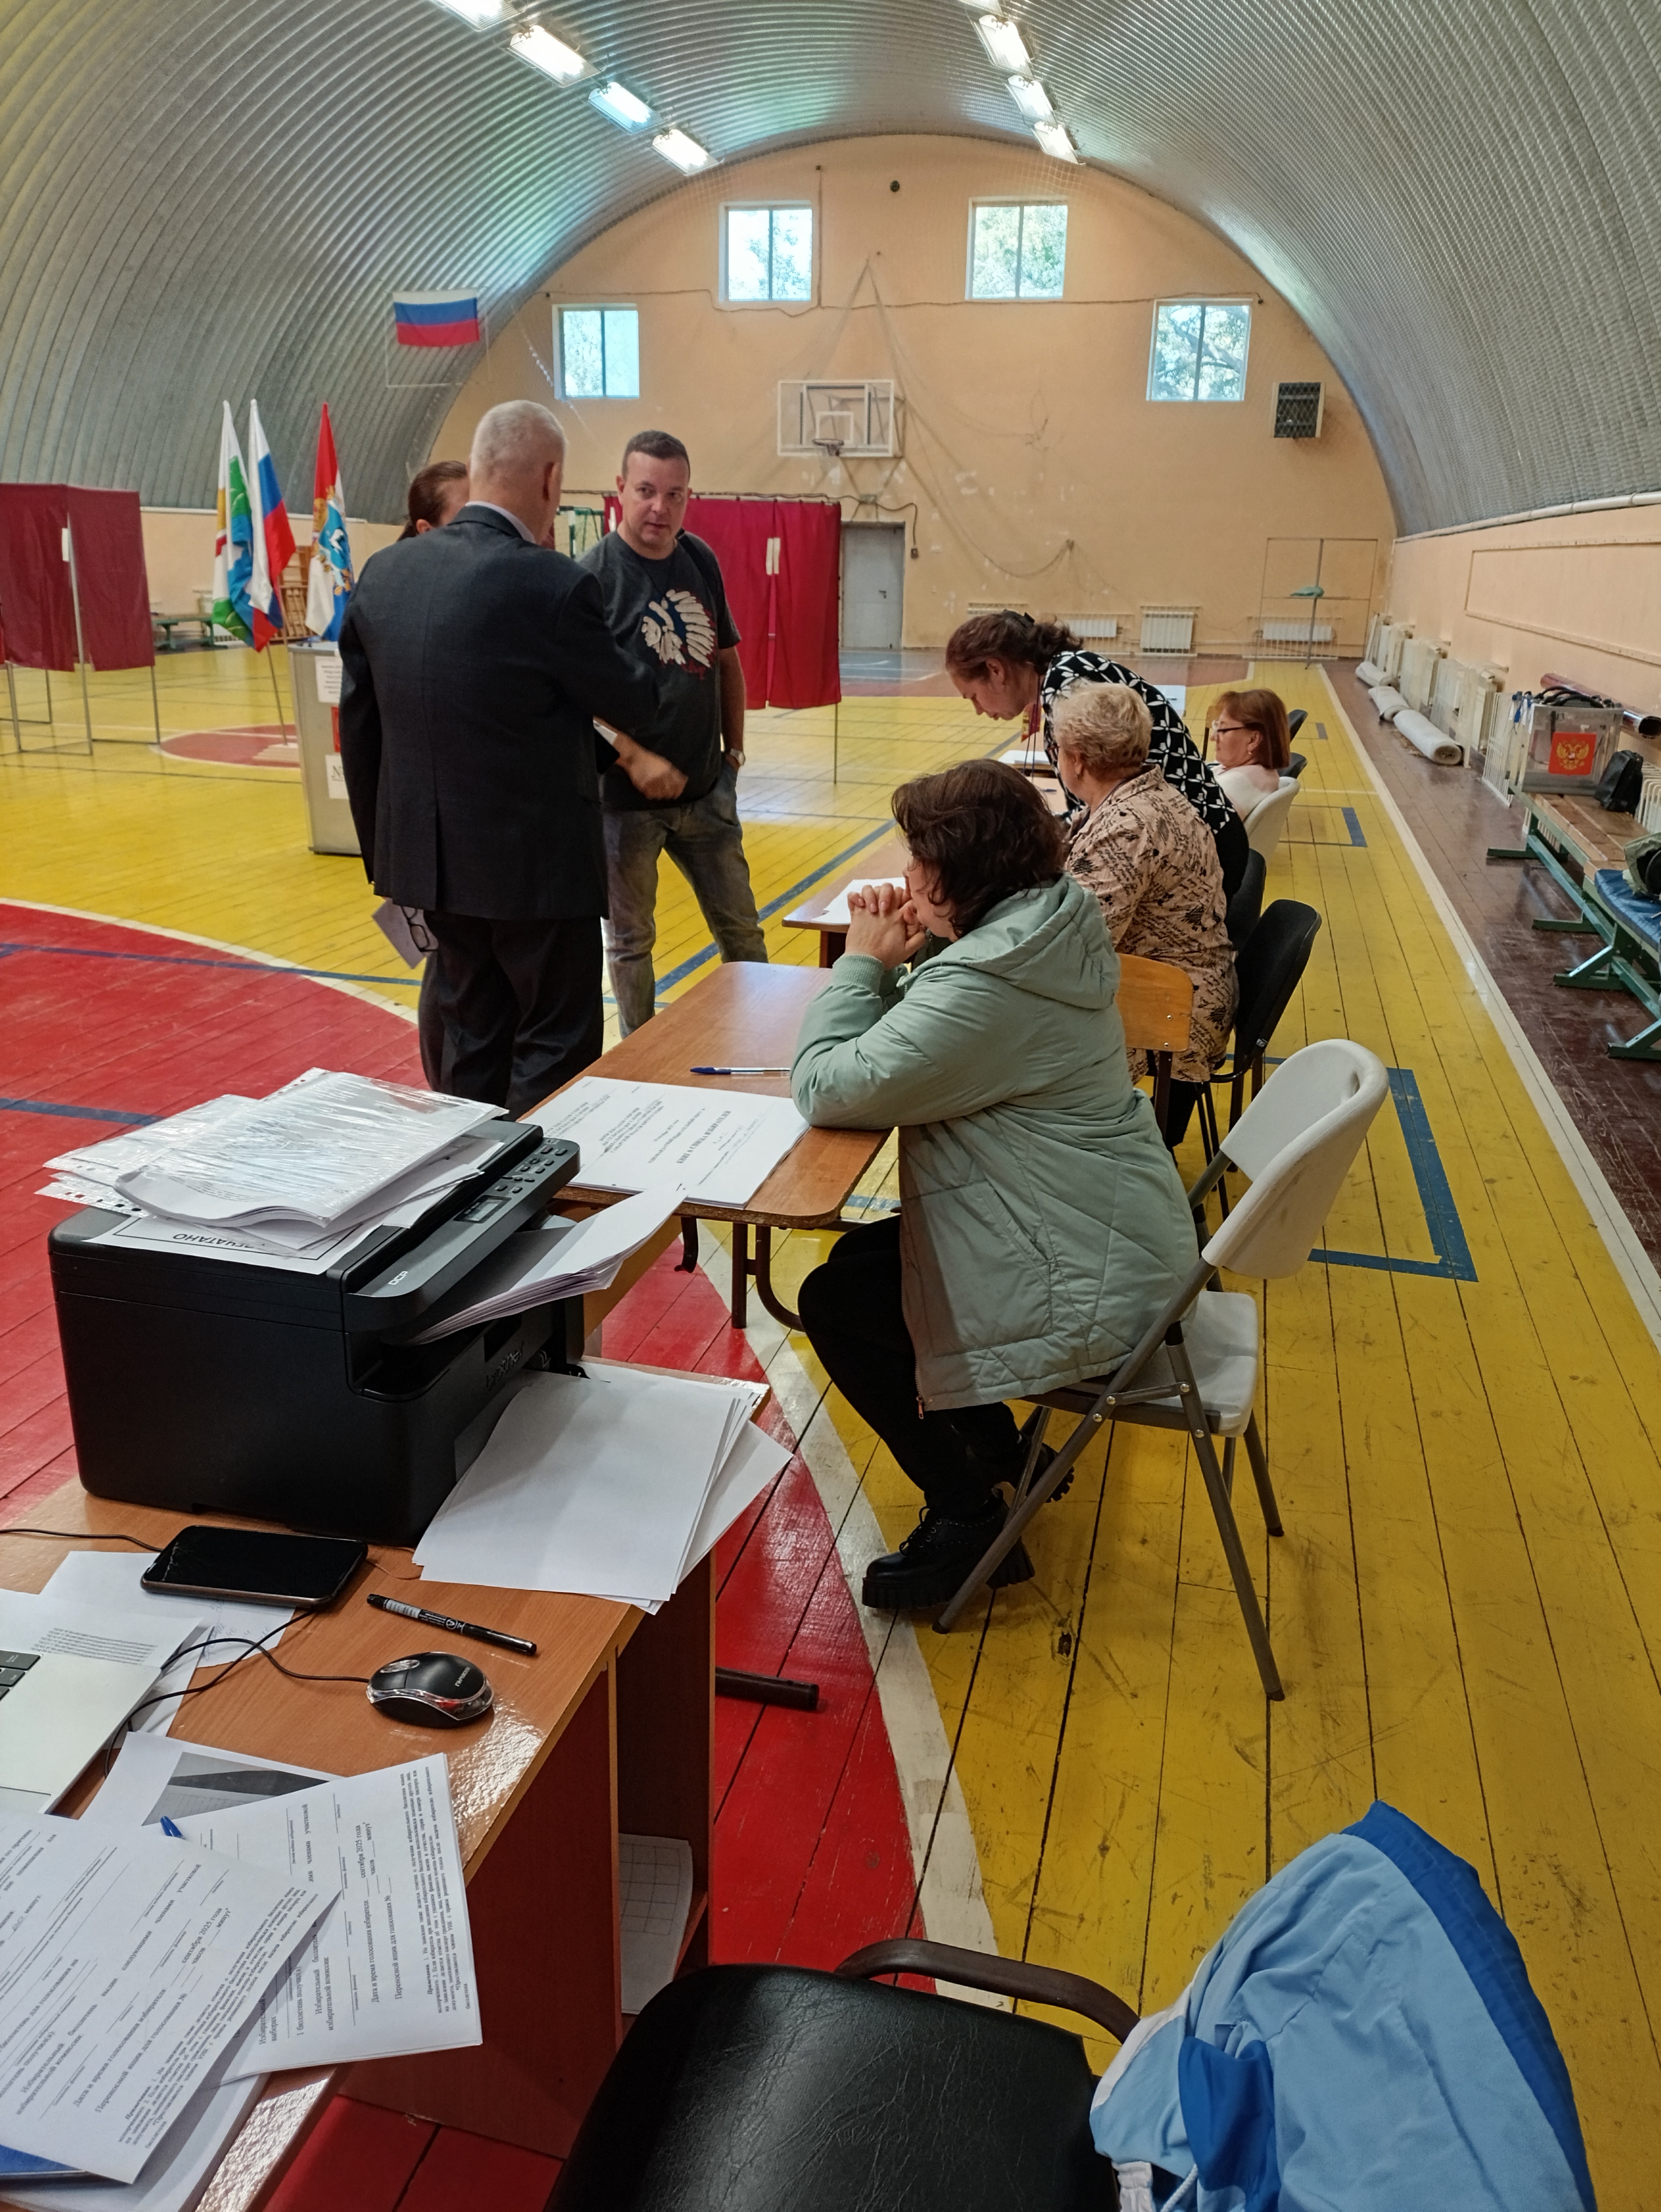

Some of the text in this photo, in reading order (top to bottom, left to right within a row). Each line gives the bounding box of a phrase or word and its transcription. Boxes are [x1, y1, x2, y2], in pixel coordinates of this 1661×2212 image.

[675, 1149, 694, 1164] КНИГА
[688, 1133, 709, 1150] СПИСКА
[703, 1110, 731, 1137] ИЗБИРАТЕЛЕЙ
[388, 1271, 408, 1285] DCP
[301, 1803, 311, 1835] участковой
[354, 1838, 364, 1853] 2025
[357, 1853, 366, 1879] сентября
[386, 1902, 395, 1934] голосования
[181, 1935, 203, 1964] сентября
[198, 1920, 212, 1936] 2025
[210, 1907, 223, 1921] года
[365, 1929, 375, 1963] голосования
[190, 1947, 206, 1964] часов
[369, 1963, 378, 1982] время
[391, 1961, 402, 2000] Переносной
[323, 1985, 334, 2031] избирательной
[371, 1987, 380, 2002] Дата
